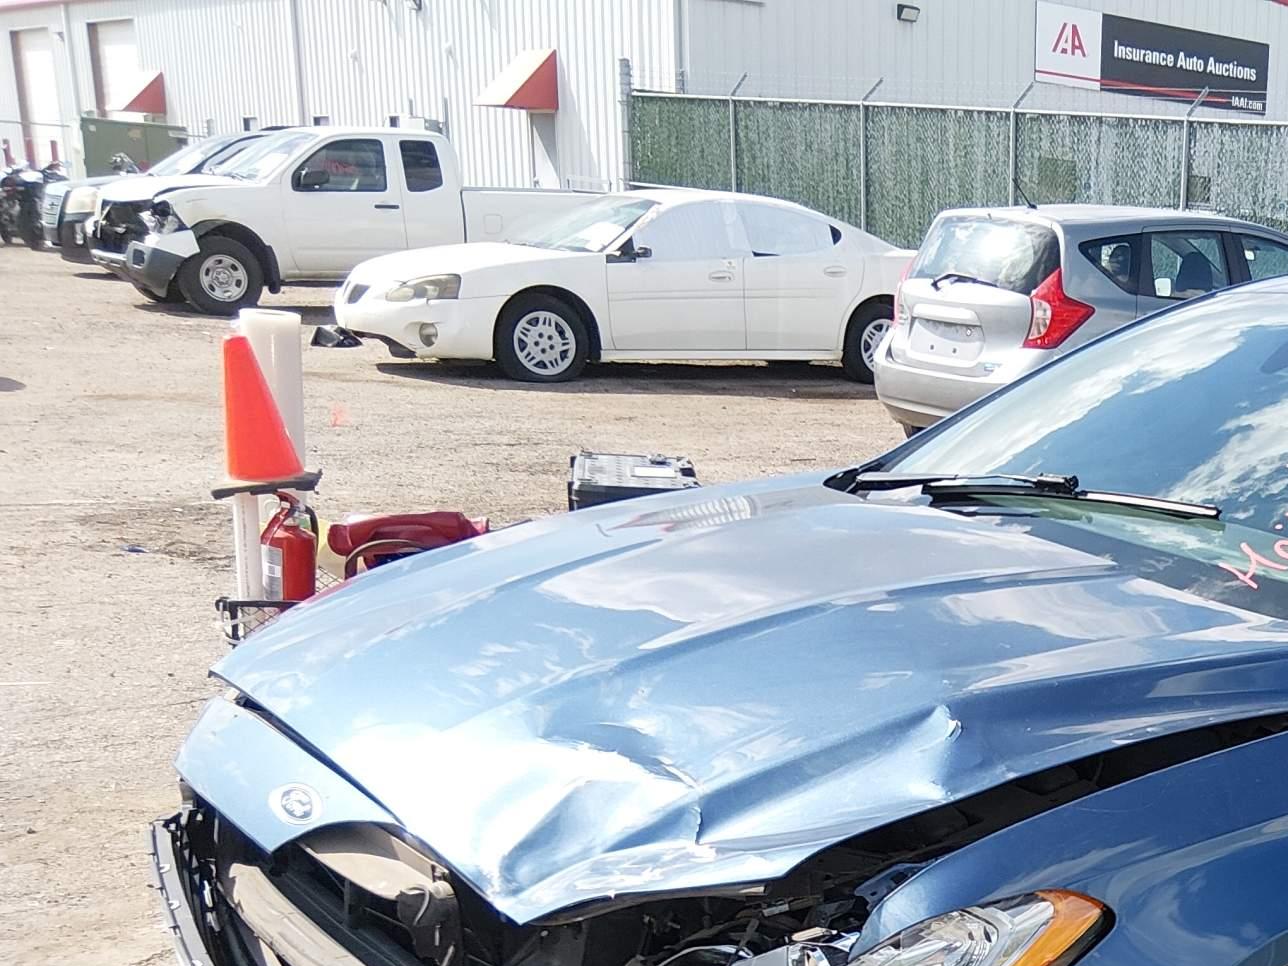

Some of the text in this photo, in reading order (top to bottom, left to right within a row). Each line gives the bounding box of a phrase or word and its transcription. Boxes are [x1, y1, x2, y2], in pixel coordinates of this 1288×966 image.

[1113, 39, 1257, 82] Insurance Auto Auctions
[1231, 95, 1263, 112] IAAI.com
